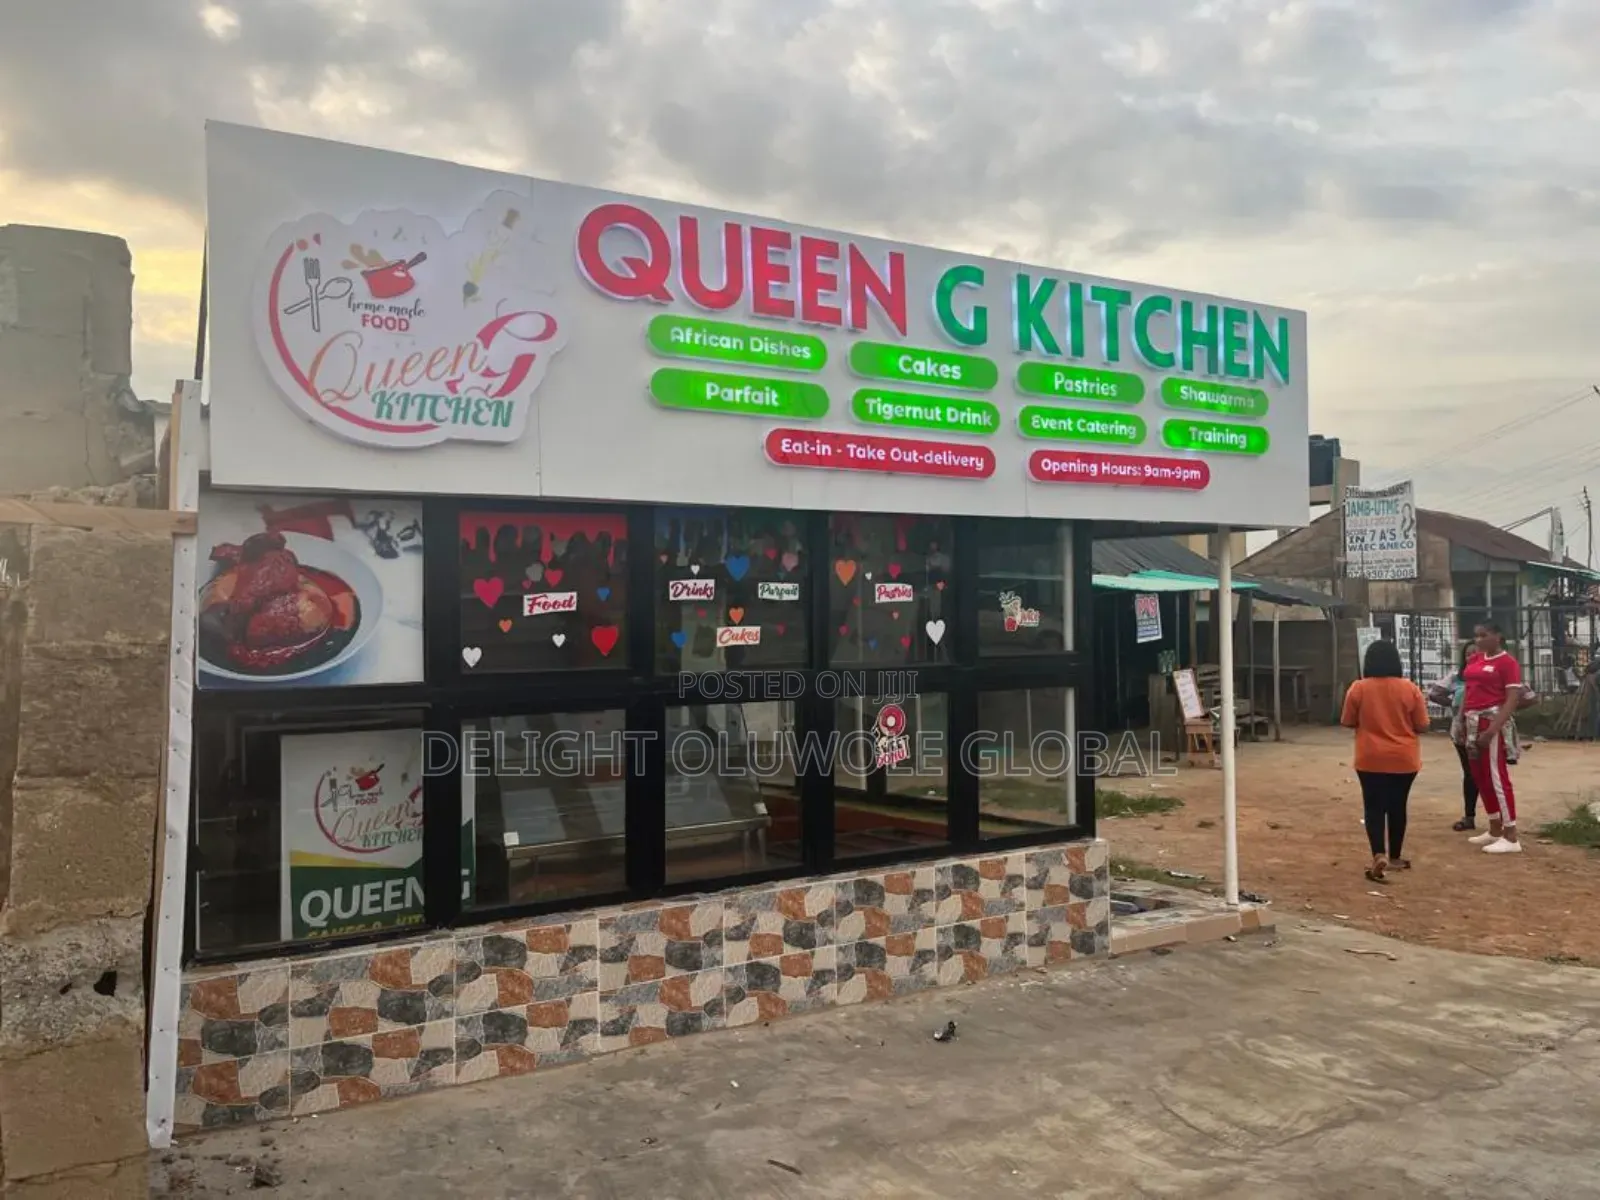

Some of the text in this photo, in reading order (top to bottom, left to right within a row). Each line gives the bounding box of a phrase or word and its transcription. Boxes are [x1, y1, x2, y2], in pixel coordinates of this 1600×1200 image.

[576, 203, 1290, 386] QUEEN G KITCHEN
[361, 313, 410, 332] FOOD
[670, 326, 812, 360] African Dishes
[308, 331, 486, 404] Queen
[898, 355, 962, 380] Cakes
[705, 381, 780, 407] Parfait
[1053, 371, 1118, 396] Pastries
[1179, 384, 1255, 408] Shawarma
[371, 390, 515, 428] KITCHEN
[865, 397, 993, 427] Tigernut Drink
[1031, 414, 1137, 439] Event Catering
[1189, 426, 1247, 448] Training
[781, 438, 832, 457] Eat-in
[846, 443, 886, 460] Take
[890, 447, 985, 471] Out-delivery
[1041, 458, 1201, 481] Opening Hours: 9am-9pm
[670, 581, 714, 598] Drinks
[526, 593, 576, 613] Food
[717, 626, 760, 643] Cakes
[300, 876, 425, 927] QUEEN
